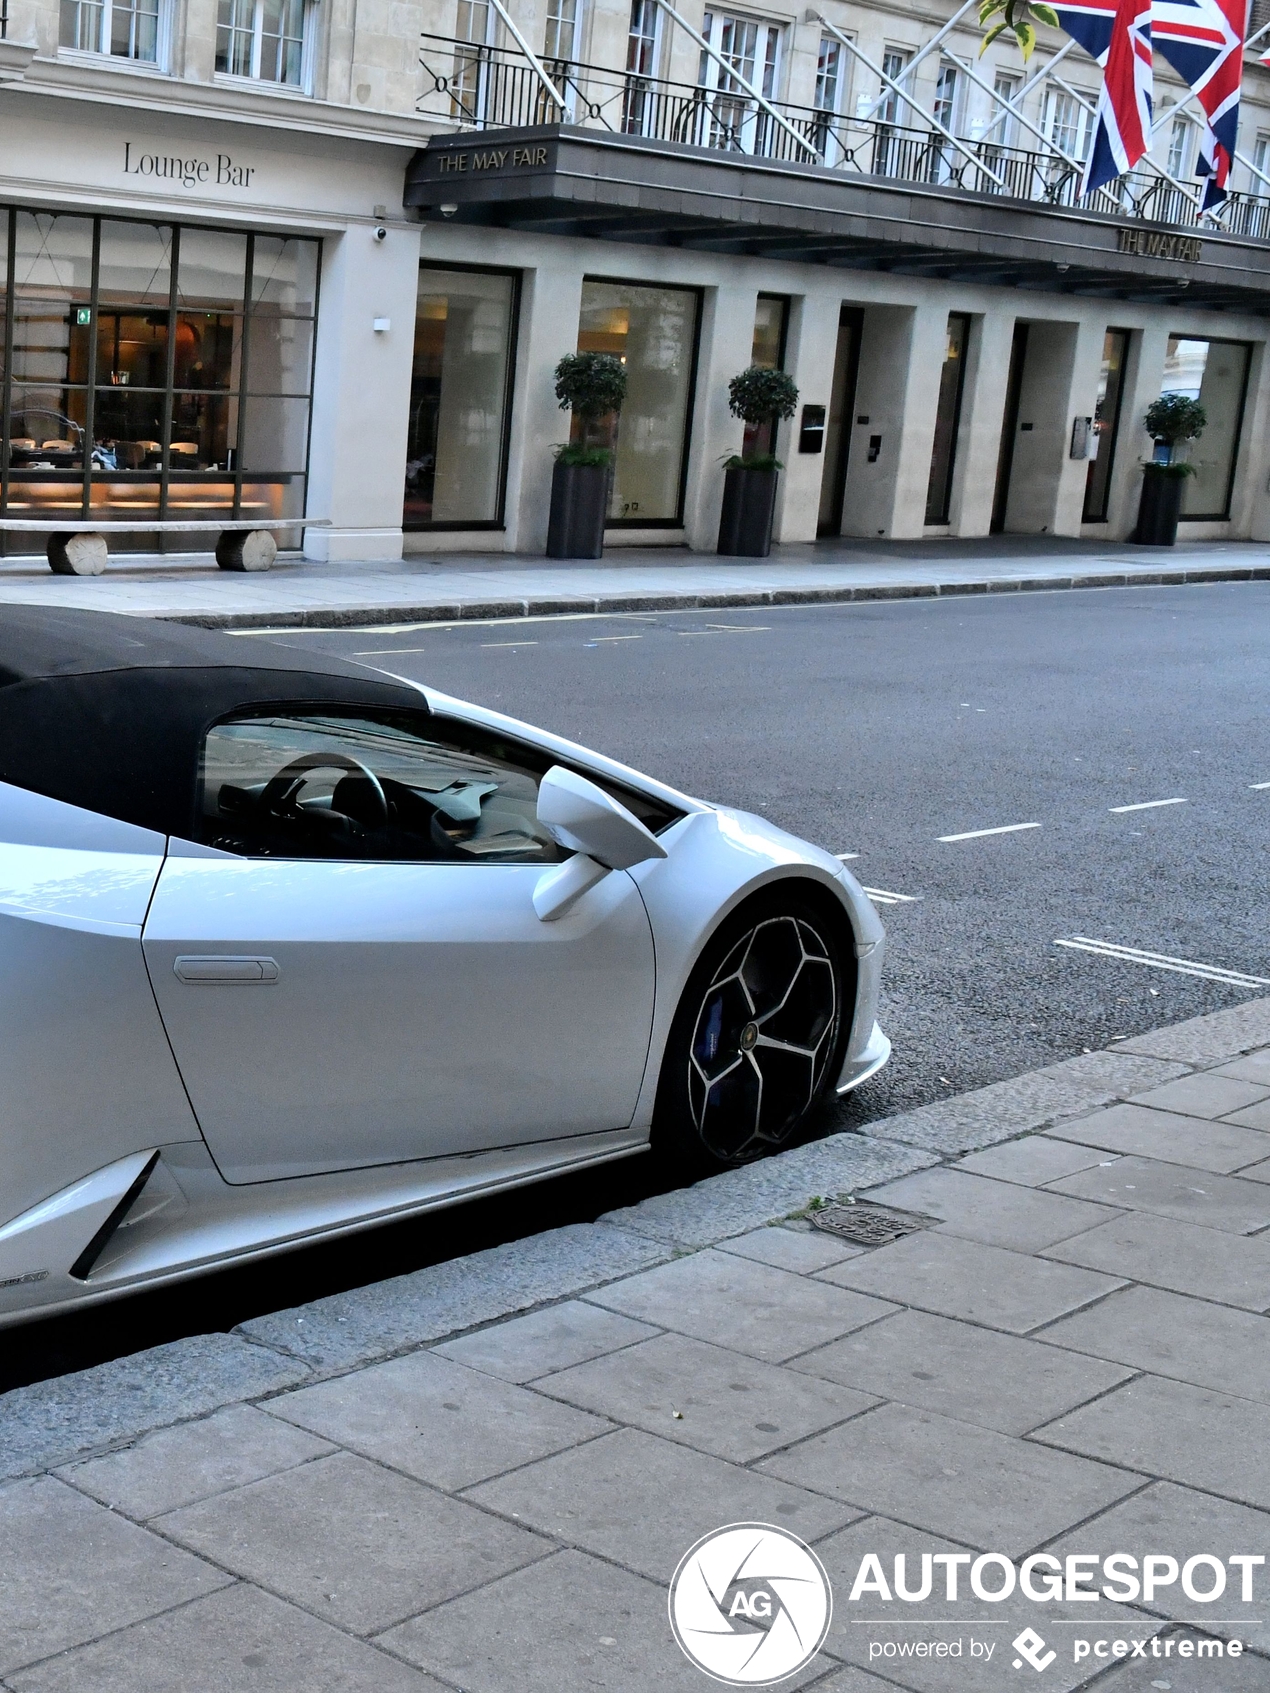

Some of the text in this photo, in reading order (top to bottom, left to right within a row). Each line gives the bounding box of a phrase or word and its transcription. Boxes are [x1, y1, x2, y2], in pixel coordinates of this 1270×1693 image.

[122, 142, 255, 189] Lounge Bar
[438, 147, 548, 173] THE MAY FAIR
[1121, 228, 1204, 262] THE MAY FAIR
